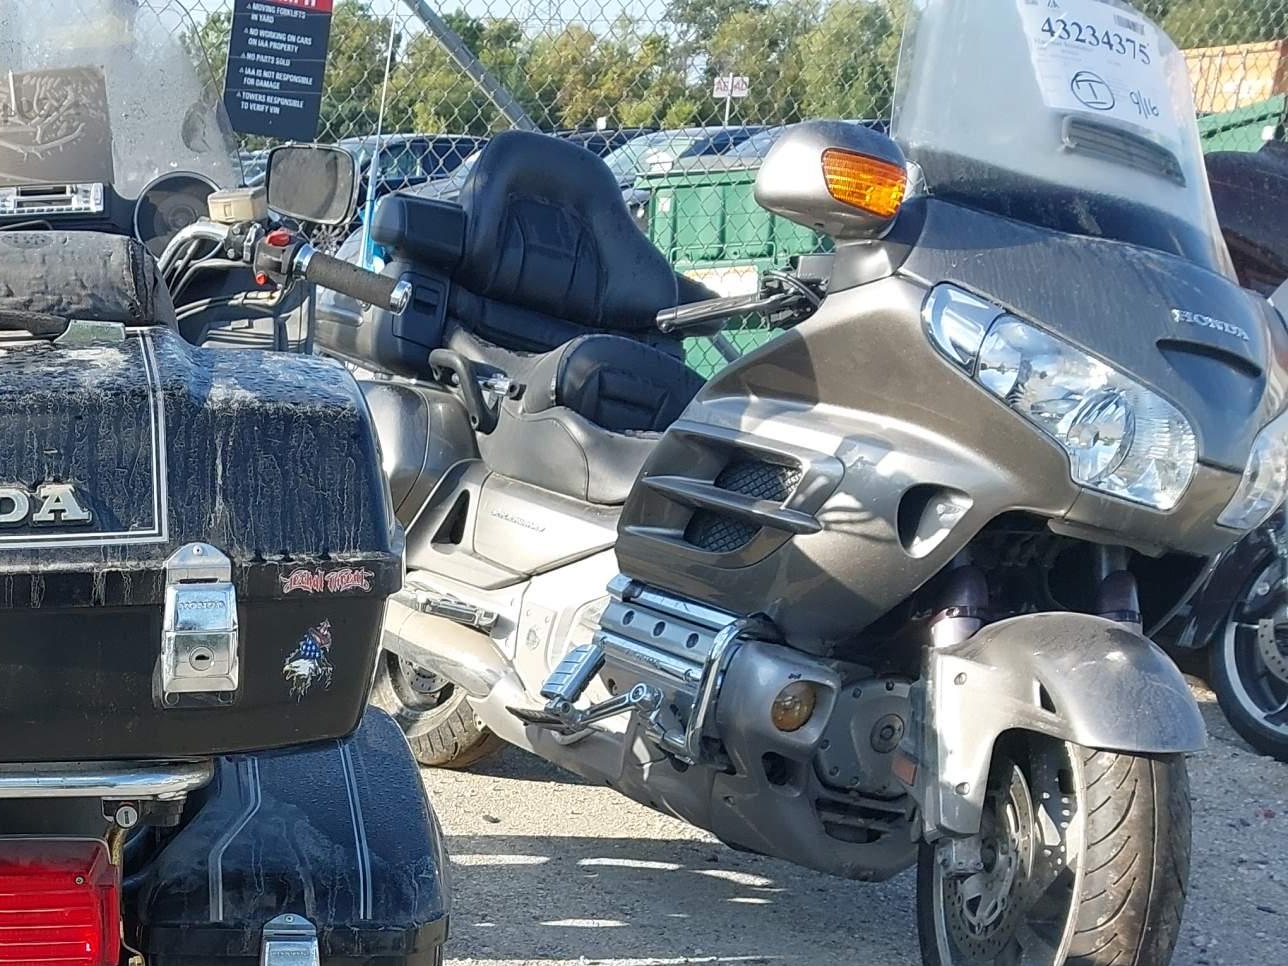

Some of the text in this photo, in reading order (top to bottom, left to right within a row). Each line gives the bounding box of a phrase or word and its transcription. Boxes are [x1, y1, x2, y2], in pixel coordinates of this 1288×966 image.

[252, 3, 276, 14] MOVING
[276, 6, 307, 19] FORKLIFTS
[259, 14, 275, 23] YARD
[249, 27, 313, 45] NO WORKING ON CARS
[1041, 16, 1151, 65] 43234375
[248, 37, 300, 53] ON IAA PROPERTY
[246, 52, 291, 66] NO PARTS SOLD
[243, 77, 281, 90] FOR DAMAGE
[244, 67, 313, 85] IAA IS NOT RESPONSIBLE
[242, 91, 304, 108] TOWERS RESPONSIBLE
[241, 101, 280, 115] TO VERIFY VIN
[1172, 308, 1250, 341] HONDA
